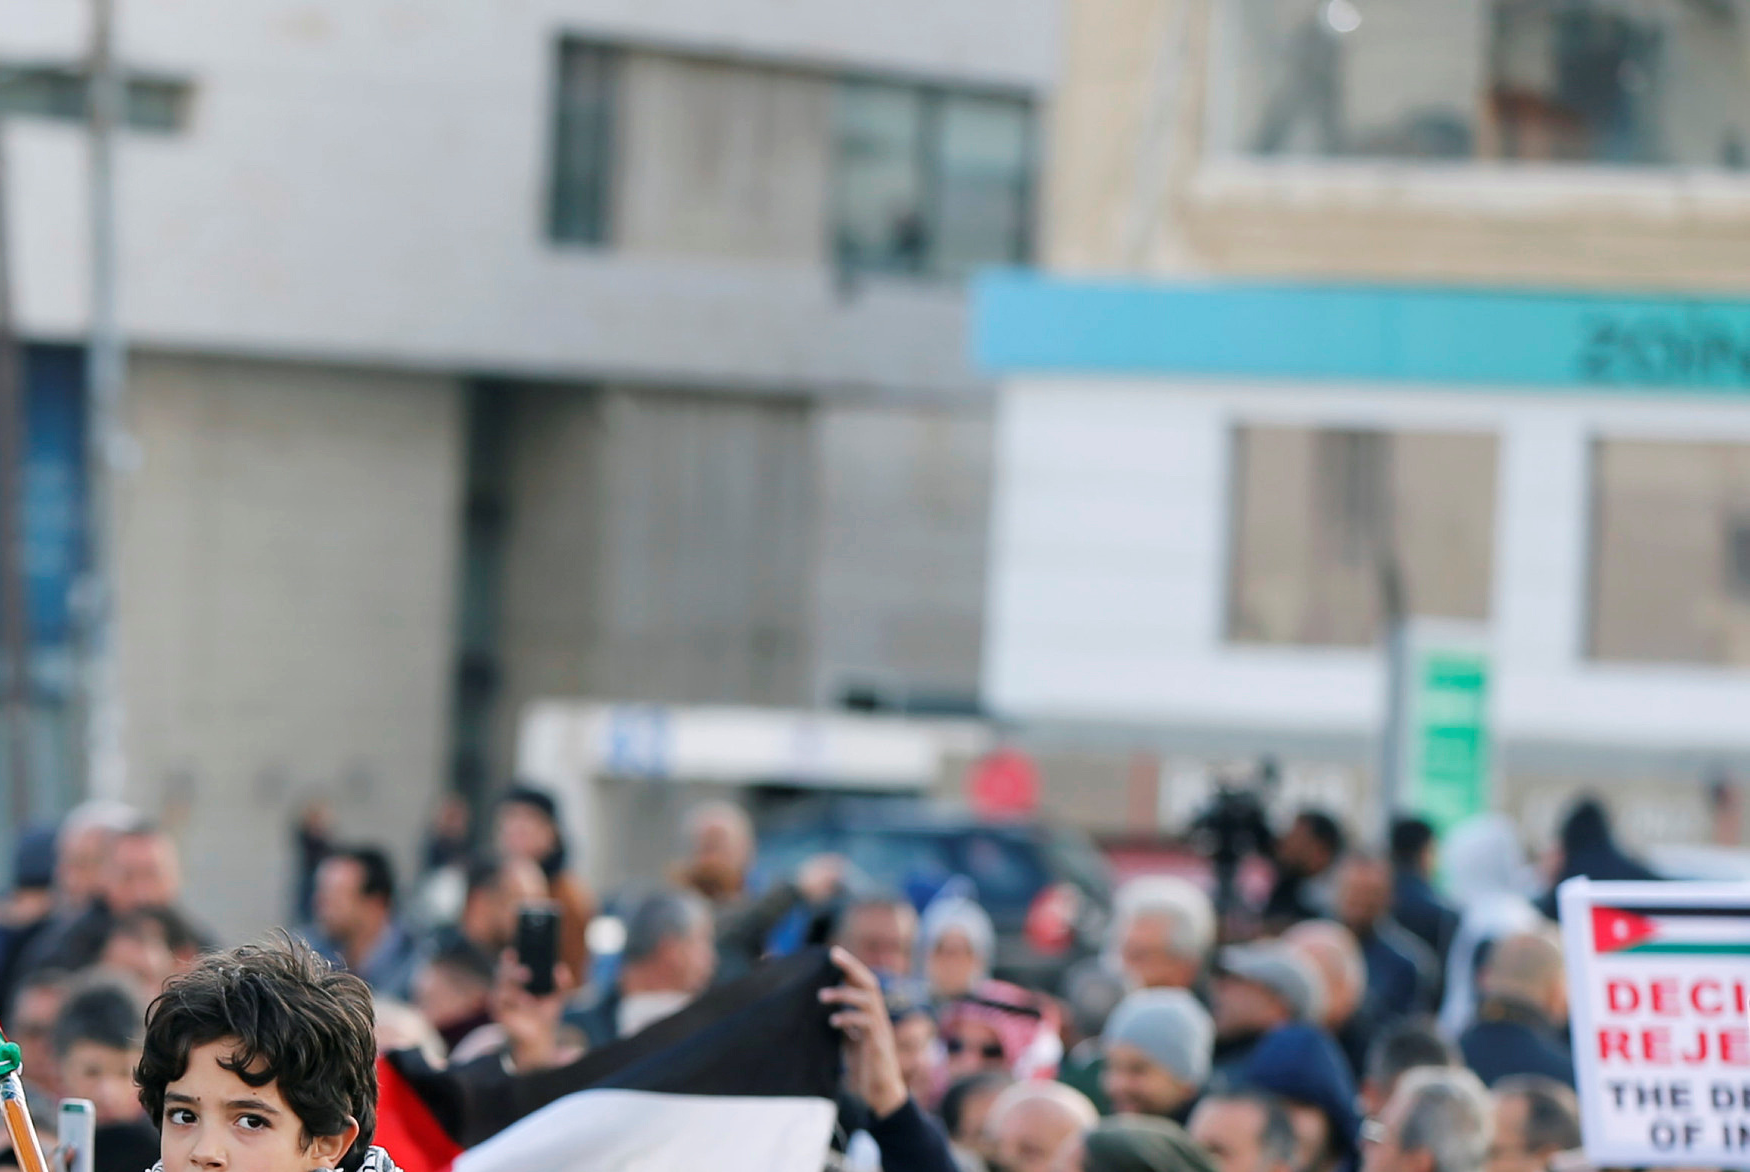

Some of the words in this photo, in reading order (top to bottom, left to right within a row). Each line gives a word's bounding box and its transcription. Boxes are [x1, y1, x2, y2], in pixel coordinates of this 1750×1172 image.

[1605, 978, 1746, 1016] DECI
[1597, 1028, 1750, 1065] REJE
[1608, 1081, 1692, 1110] THE
[1650, 1120, 1702, 1151] OF
